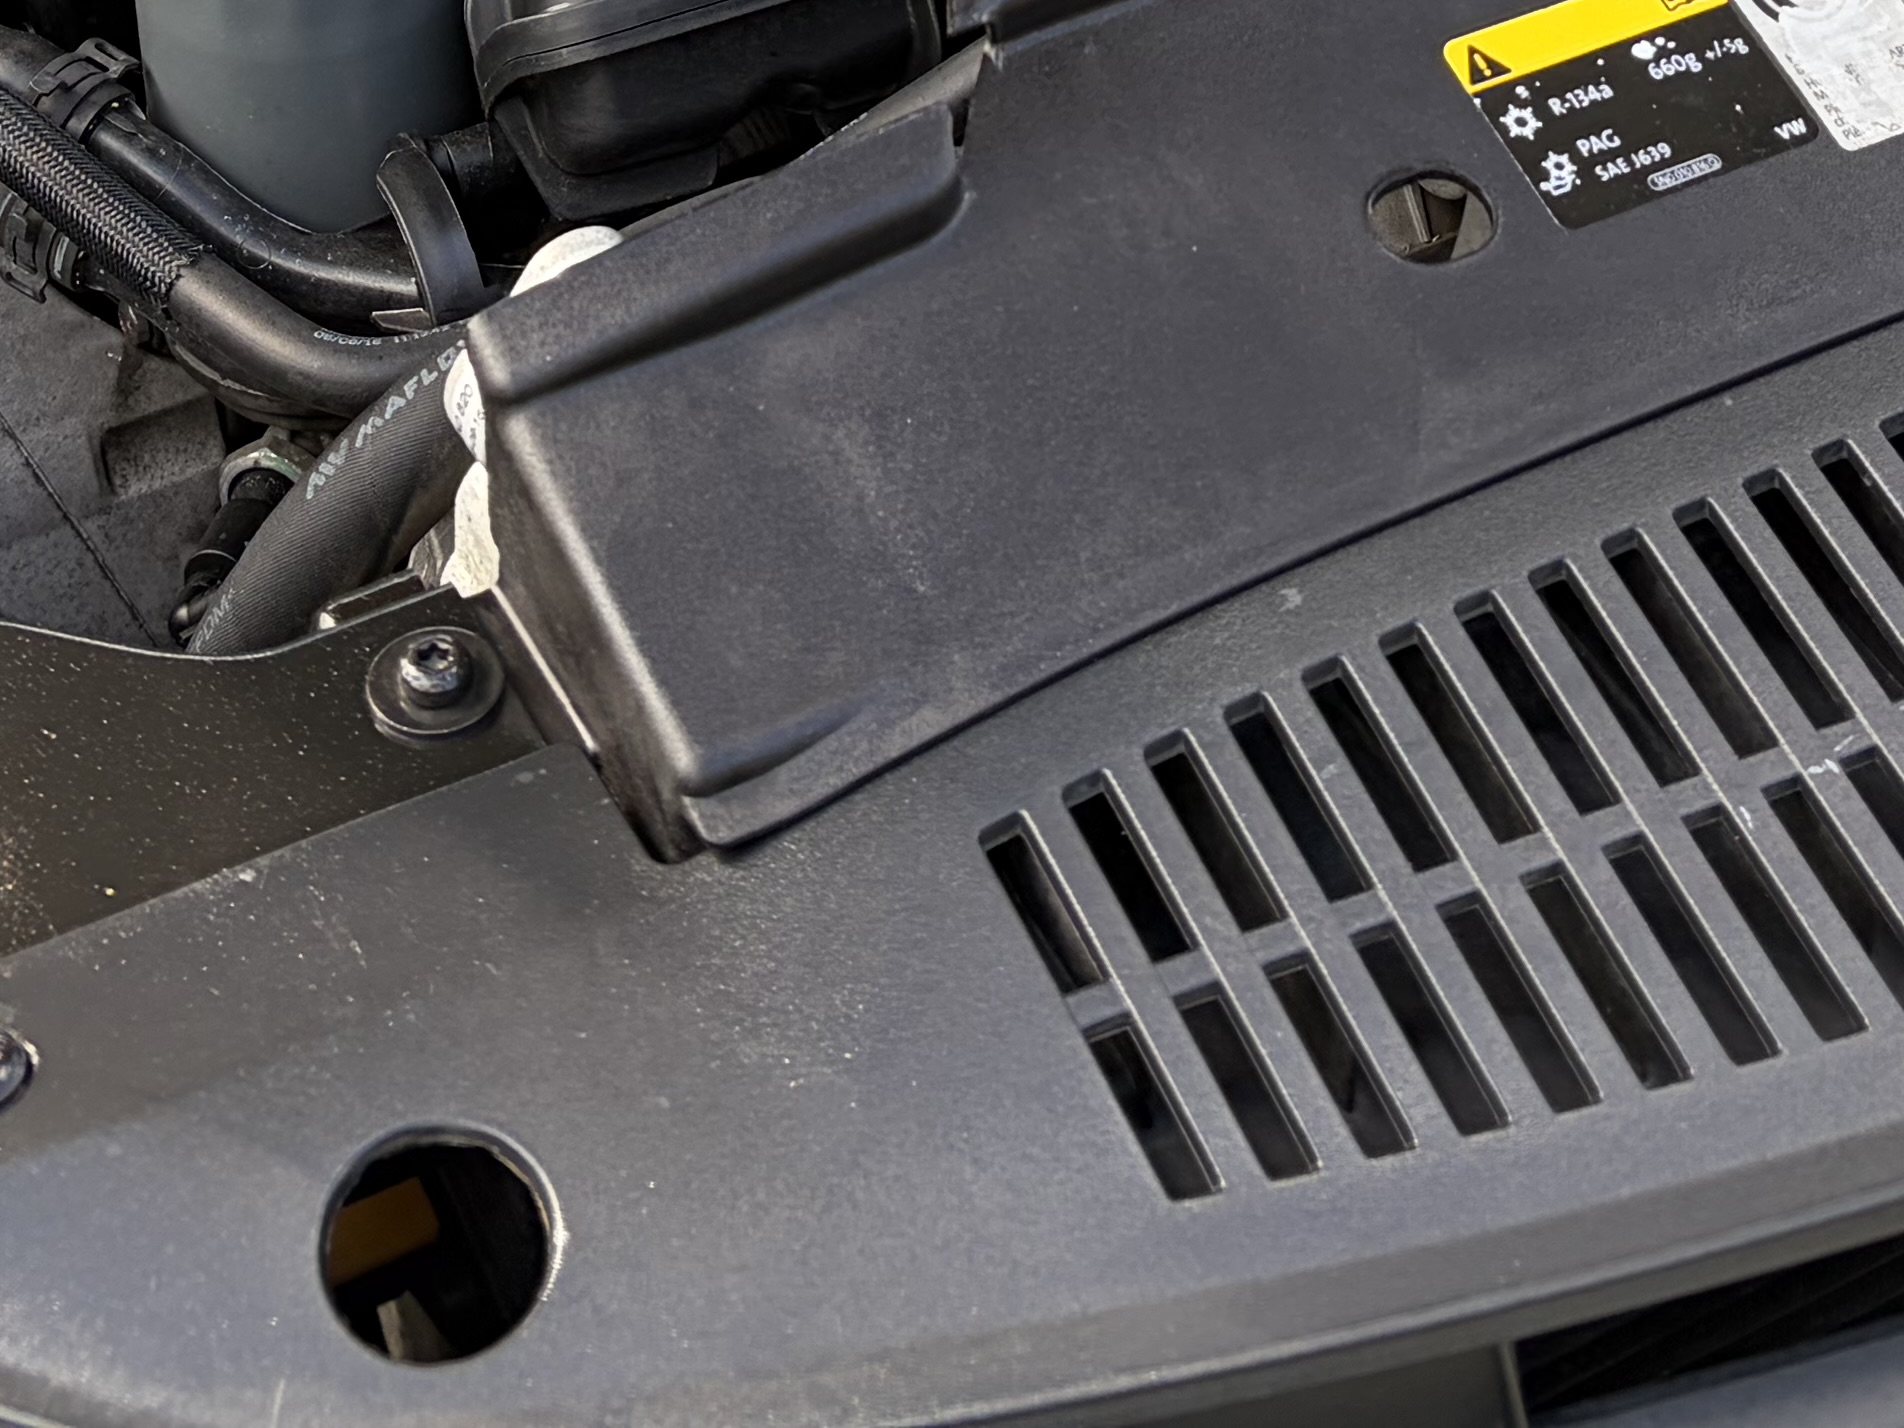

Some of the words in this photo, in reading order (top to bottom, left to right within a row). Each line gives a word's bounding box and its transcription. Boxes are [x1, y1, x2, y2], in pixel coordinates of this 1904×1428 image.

[1646, 48, 1702, 81] 660g
[1545, 79, 1616, 117] R-134a
[1574, 127, 1623, 158] PAG
[1772, 116, 1810, 141] VW
[1593, 156, 1632, 182] SAE
[1628, 140, 1675, 168] J639
